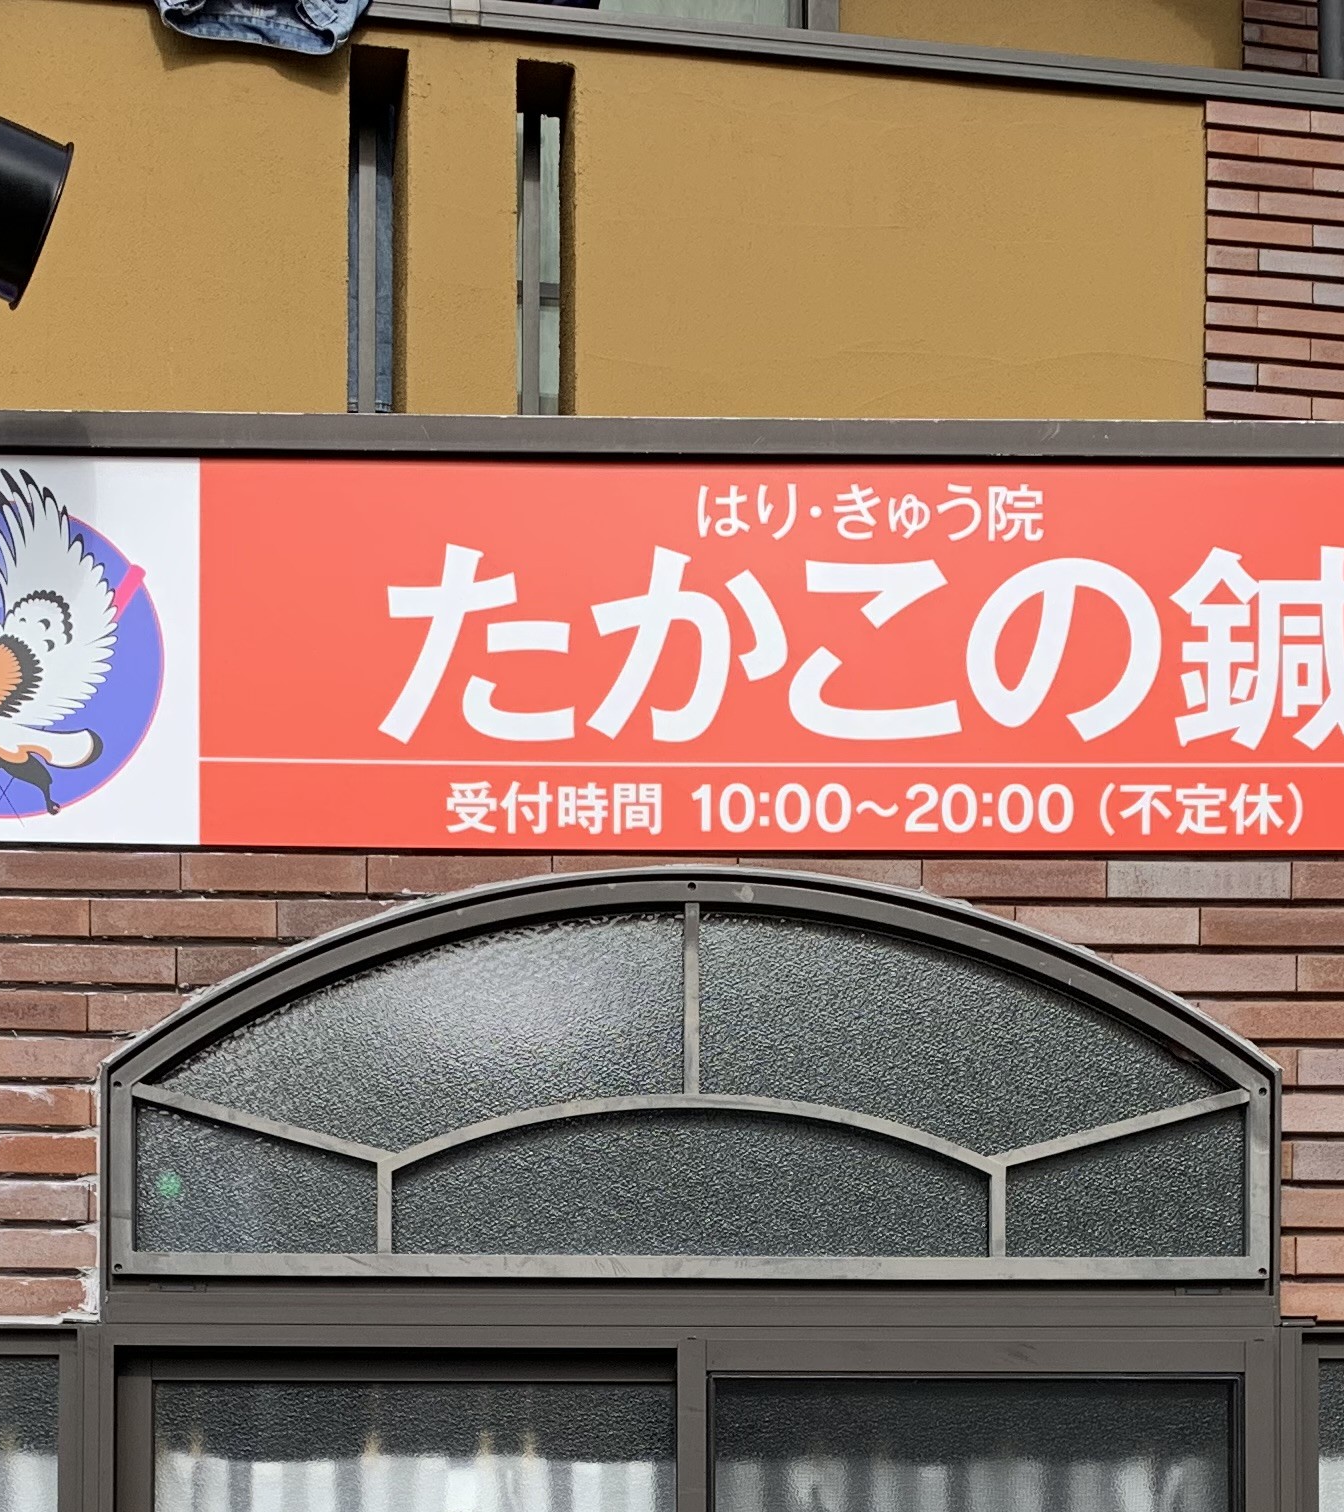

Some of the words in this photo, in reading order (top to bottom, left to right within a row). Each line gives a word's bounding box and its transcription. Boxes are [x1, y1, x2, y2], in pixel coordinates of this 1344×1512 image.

[696, 483, 1044, 542] はり・きゅう院
[446, 781, 662, 835] 受付時間
